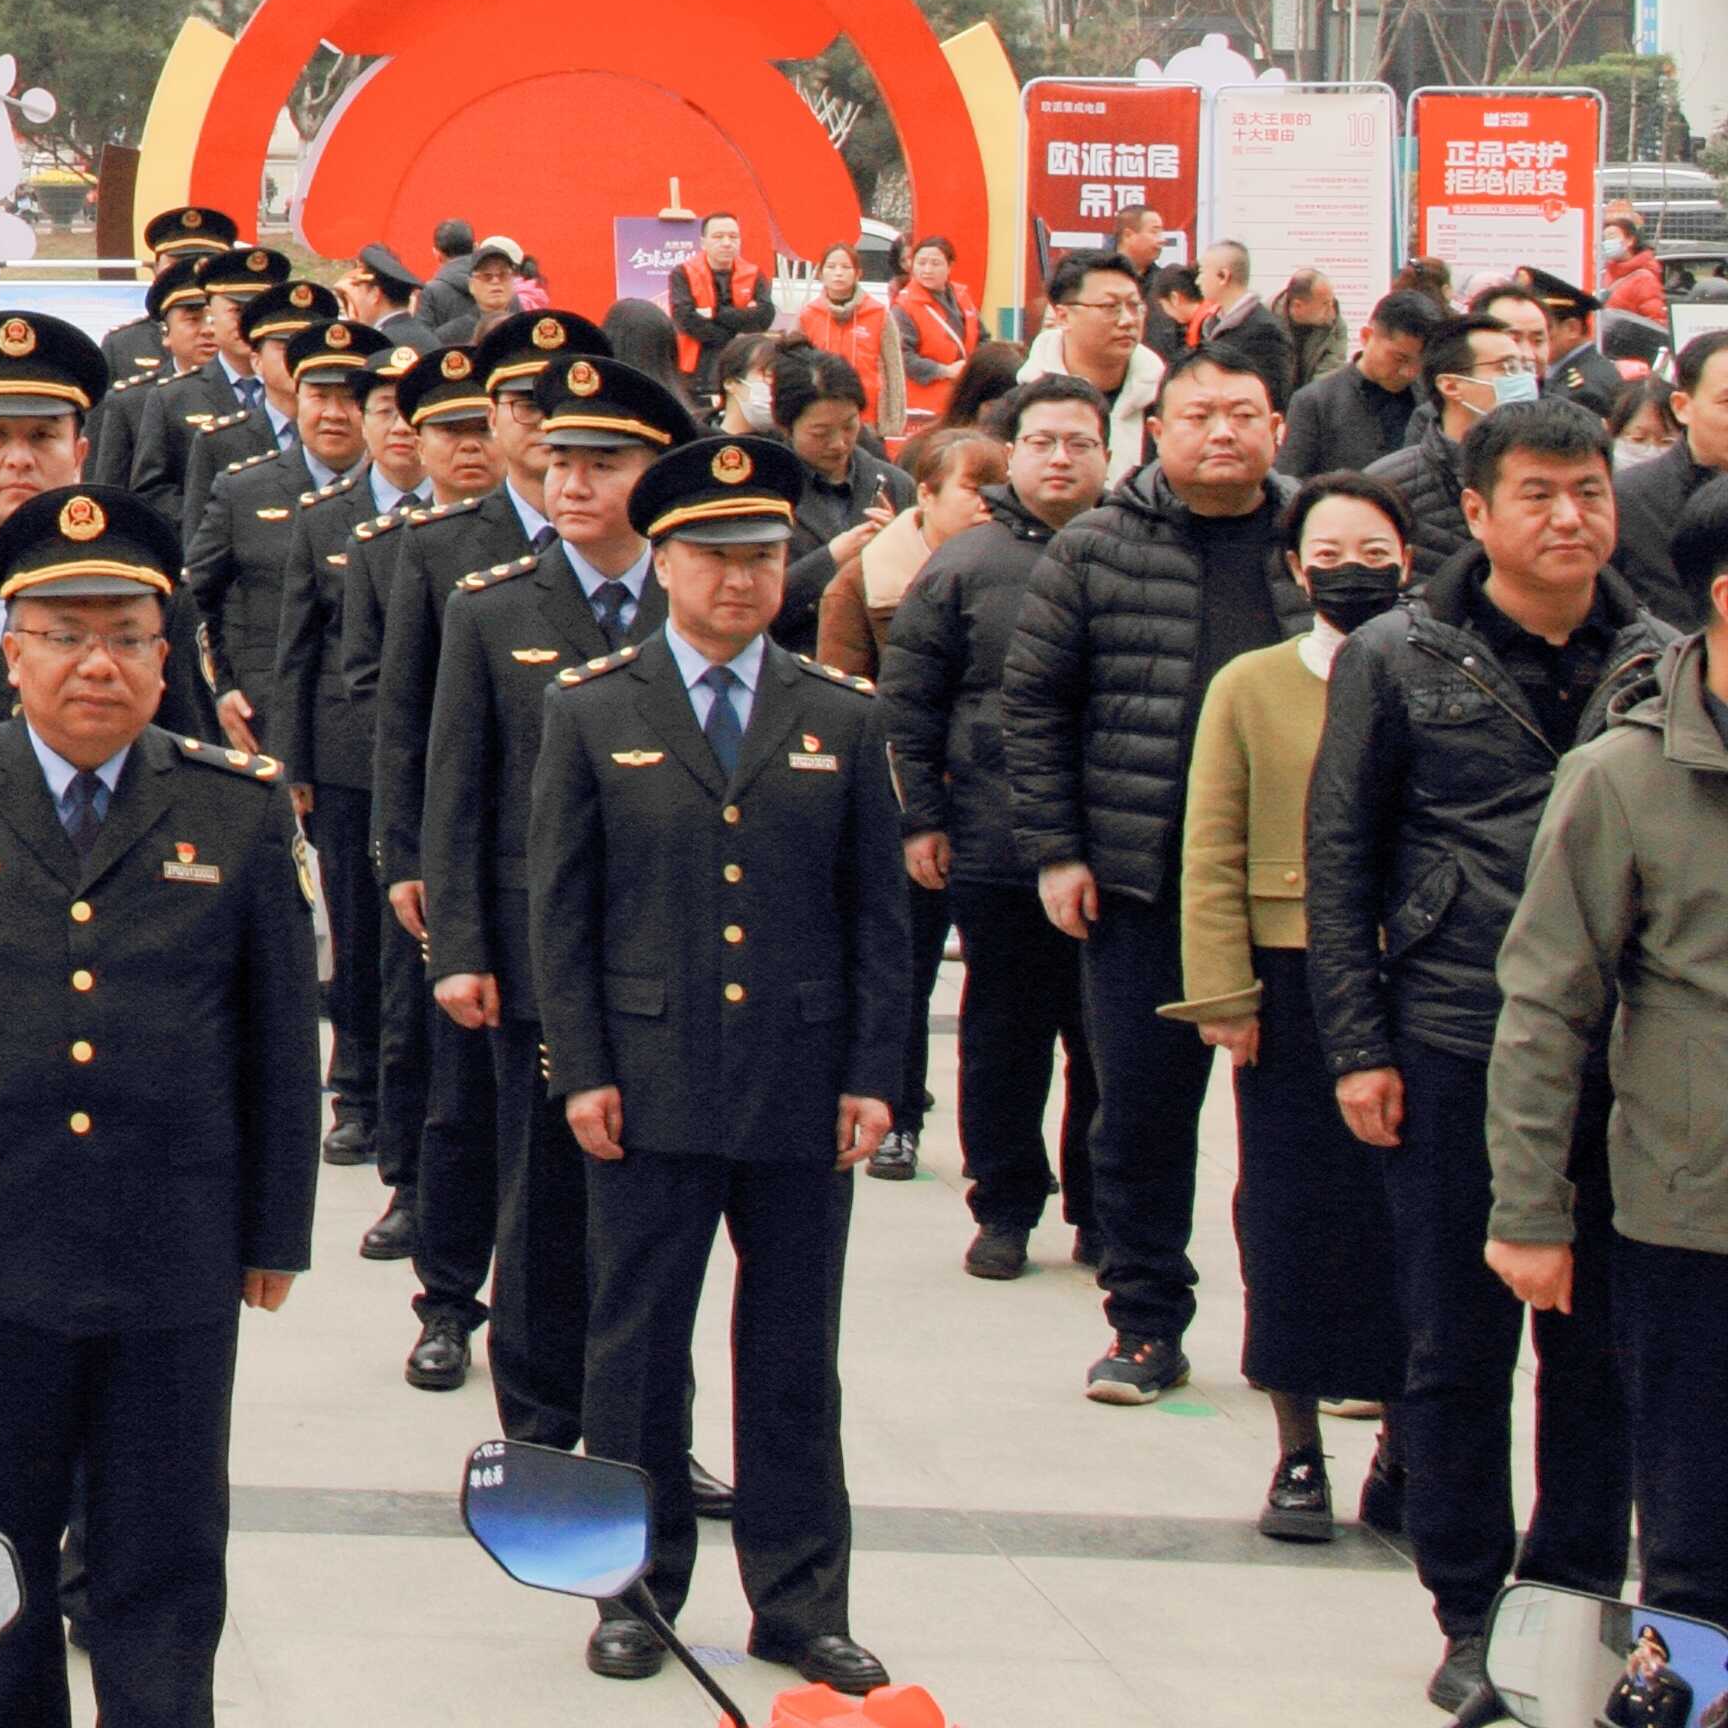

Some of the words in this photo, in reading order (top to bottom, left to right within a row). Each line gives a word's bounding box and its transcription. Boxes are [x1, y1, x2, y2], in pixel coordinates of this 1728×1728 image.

[1233, 127, 1295, 142] 十大理由
[1348, 113, 1375, 147] 10
[1047, 141, 1179, 179] 欧派芯居
[1445, 140, 1568, 168] 正品守护
[1445, 168, 1568, 197] 拒绝假货
[1079, 183, 1147, 217] 吊顶
